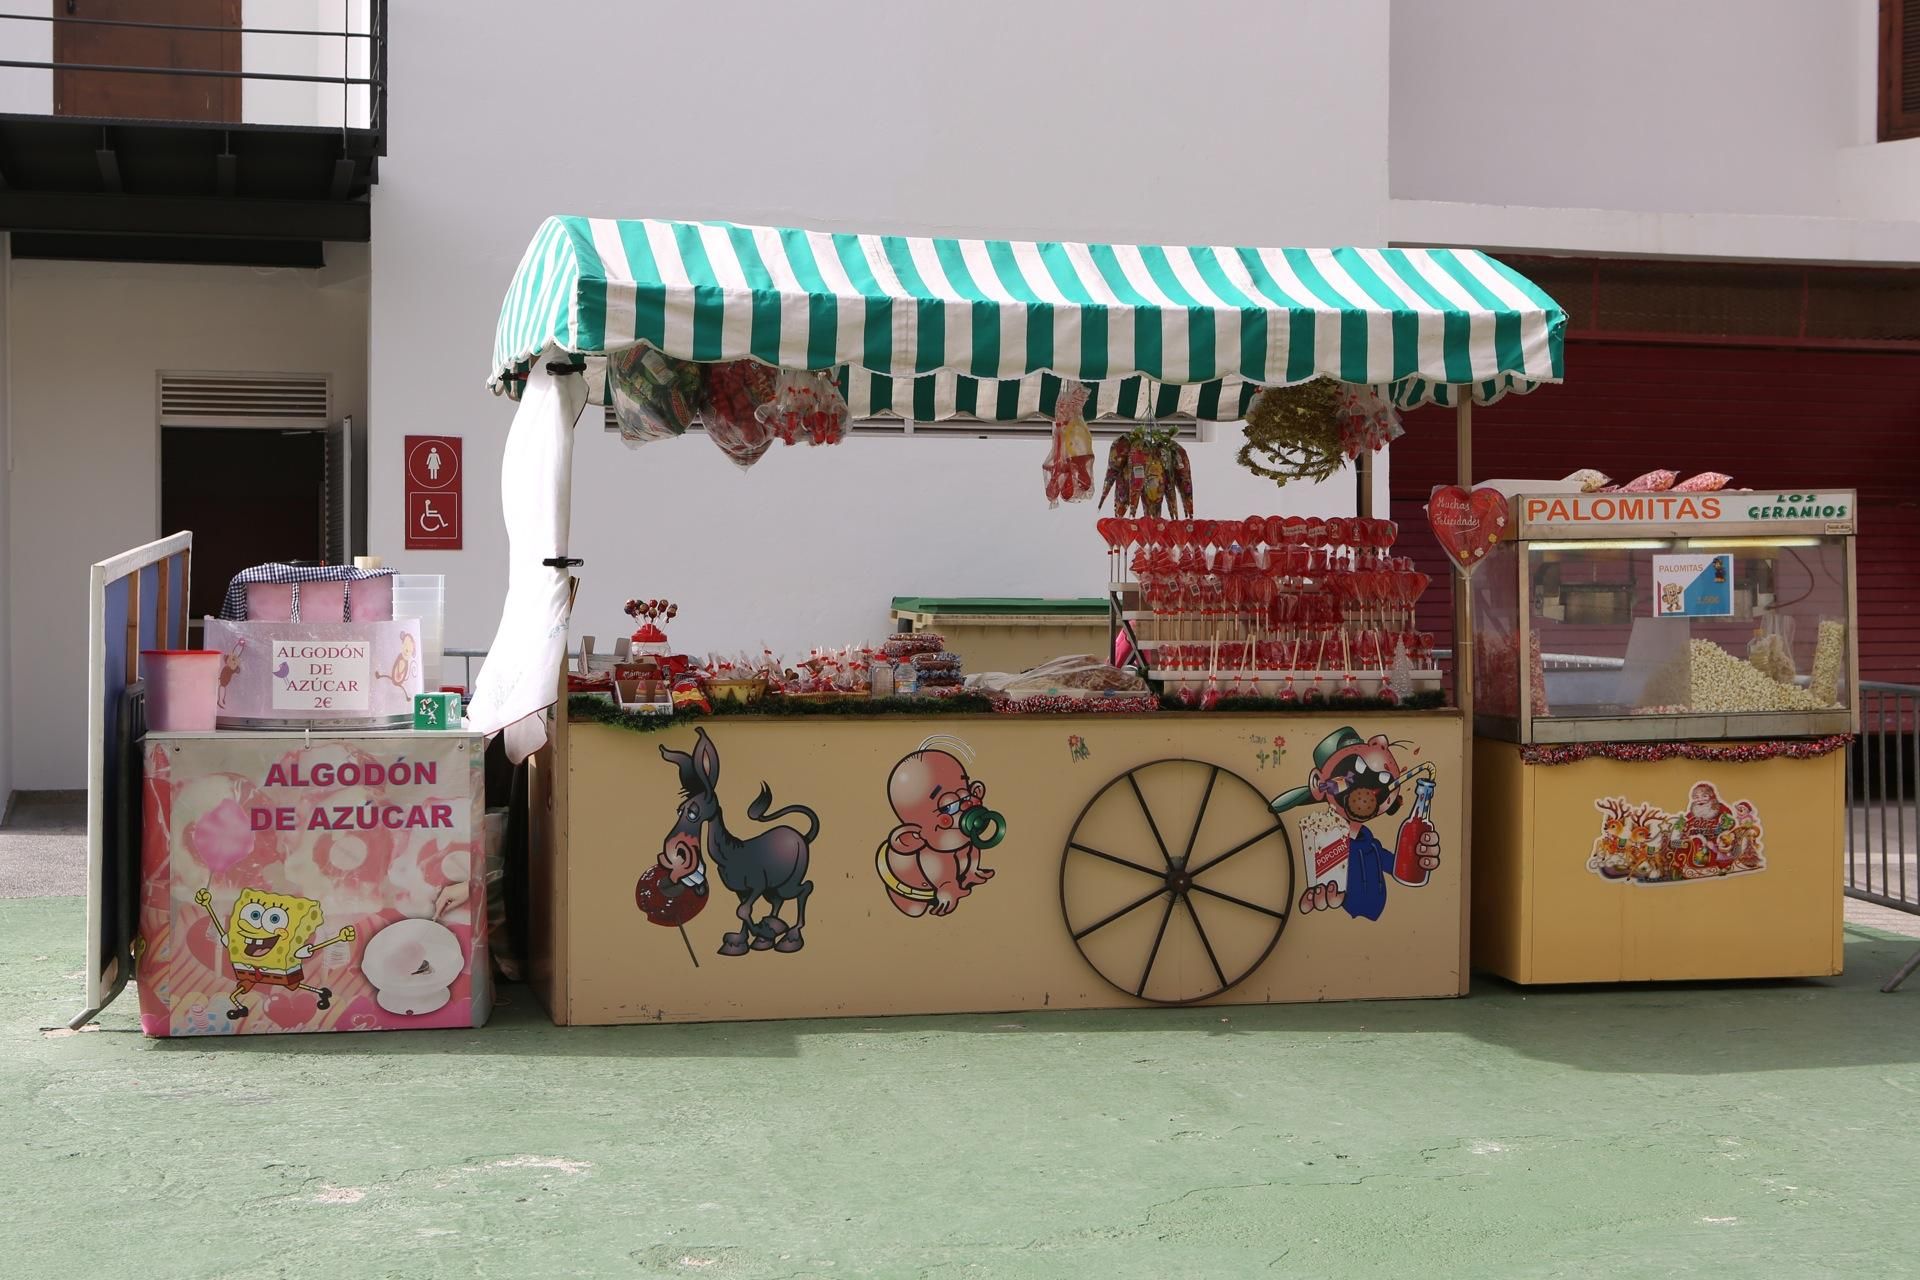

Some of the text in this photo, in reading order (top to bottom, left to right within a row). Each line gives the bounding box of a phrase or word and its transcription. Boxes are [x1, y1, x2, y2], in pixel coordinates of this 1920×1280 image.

[1436, 496, 1470, 511] Muchas
[1777, 494, 1817, 503] LOS
[1527, 497, 1722, 522] PALOMITAS
[1748, 505, 1847, 519] GERANIOS
[1658, 564, 1704, 573] PALOMITAS
[277, 644, 364, 659] ALGODÓN
[309, 663, 333, 676] DE
[286, 677, 359, 693] AZÚCAR
[313, 697, 333, 709] 2€
[265, 757, 437, 787] ALGODÓN
[250, 800, 453, 831] DE AZÚCAR
[1316, 842, 1348, 867] POPCORN
